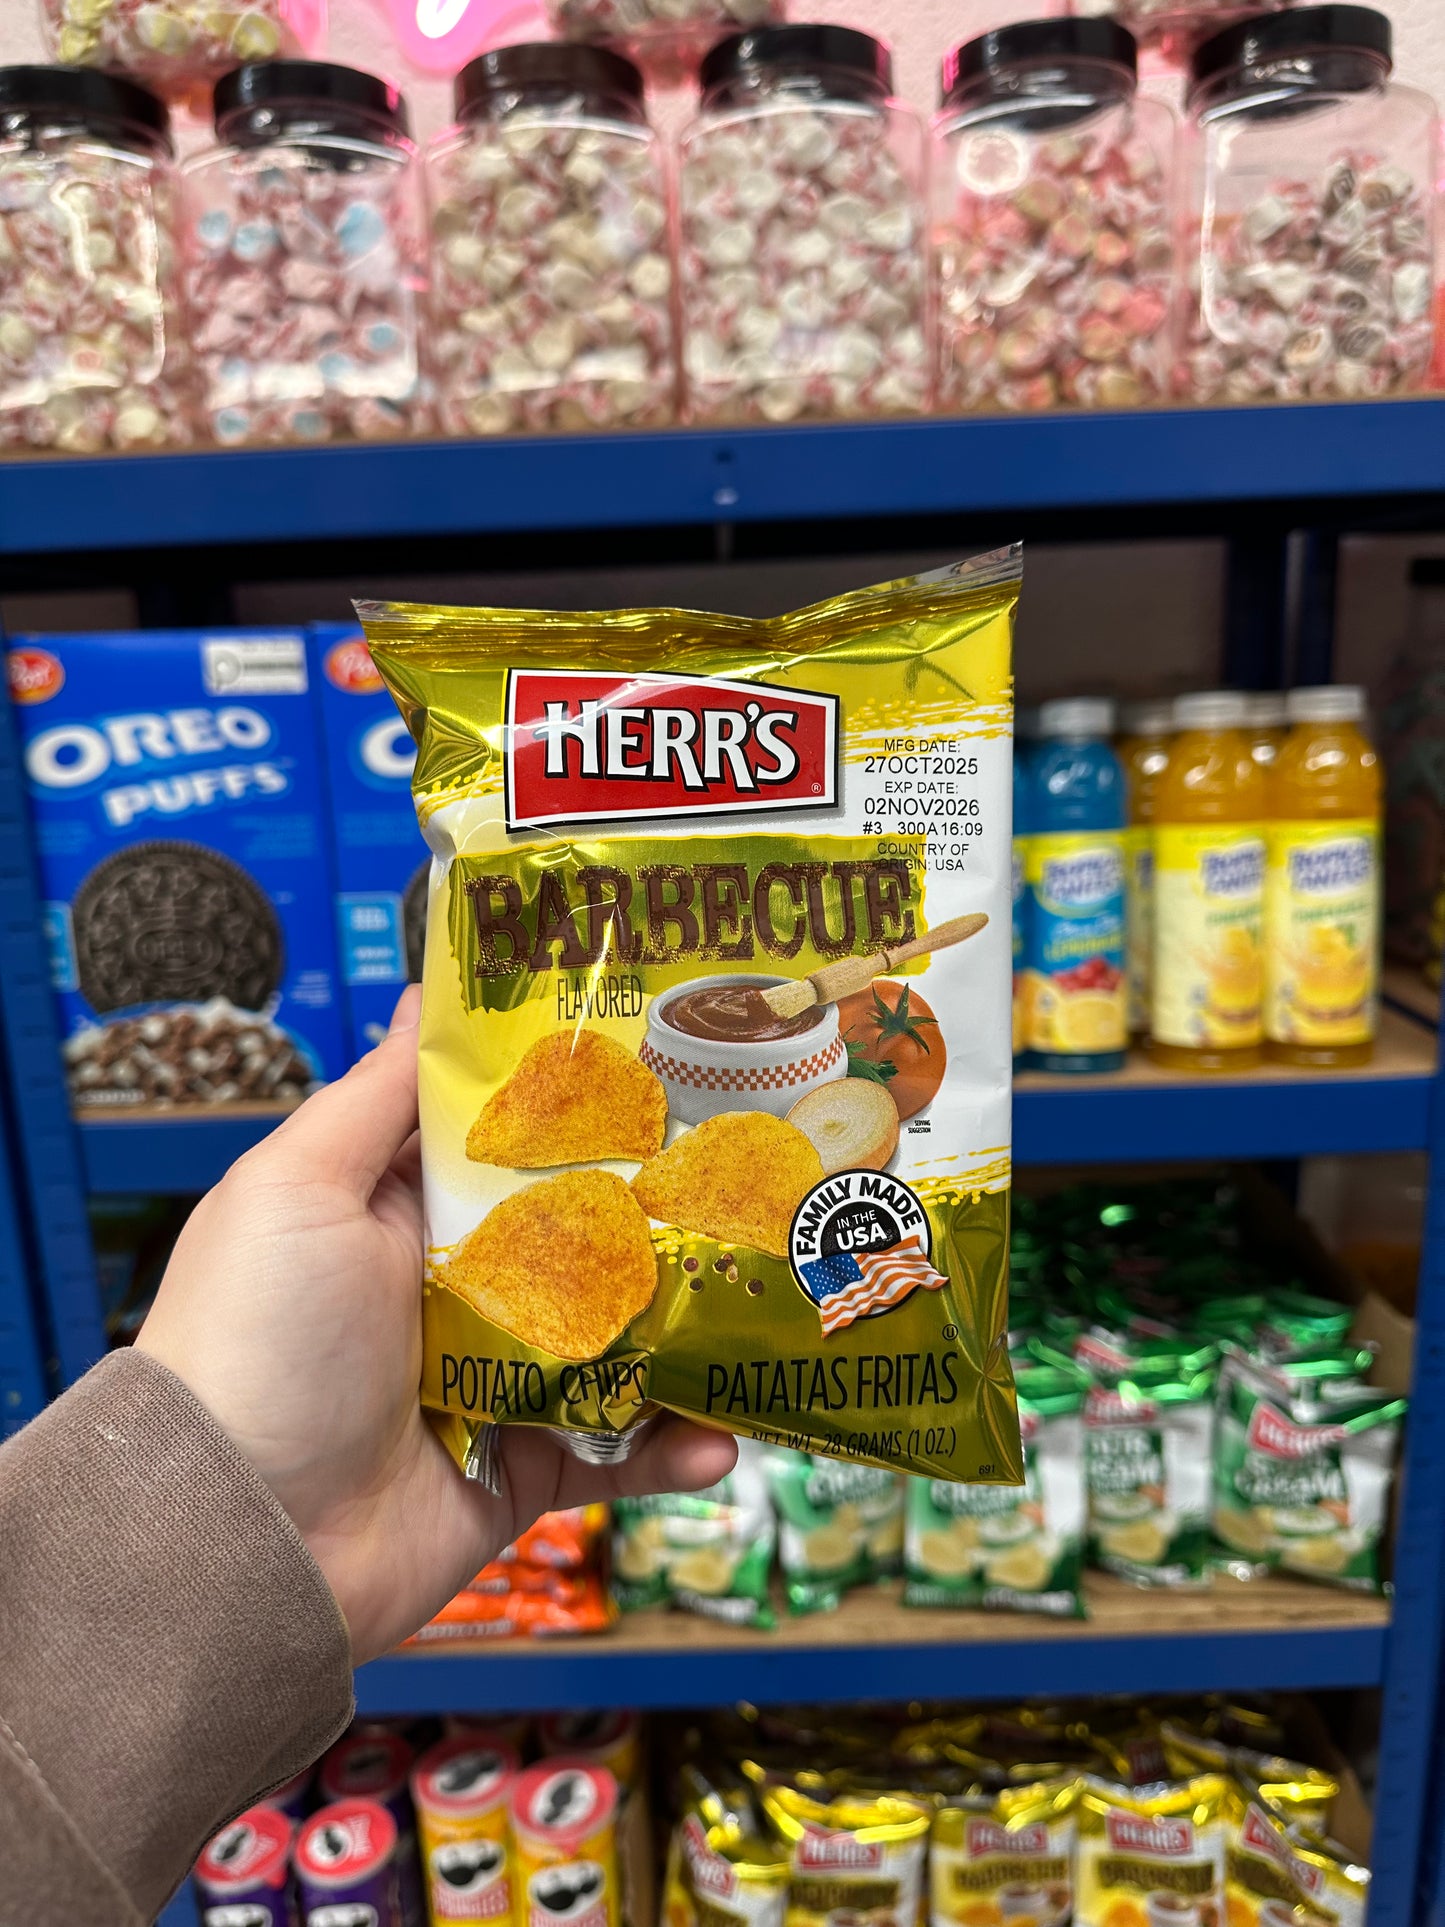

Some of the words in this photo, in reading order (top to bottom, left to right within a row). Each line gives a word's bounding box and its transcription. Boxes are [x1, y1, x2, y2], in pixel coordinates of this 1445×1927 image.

[24, 706, 271, 788] OREO
[532, 699, 799, 792] HERR'S
[884, 739, 915, 752] MFG
[919, 739, 961, 753] DATE:
[864, 755, 978, 775] 27OCT2025
[103, 762, 287, 827] PUFFS
[884, 781, 913, 793] EXP
[917, 782, 959, 794] DATE:
[864, 797, 980, 816] 02NOV2026
[863, 821, 883, 835] #3
[877, 842, 947, 856] COUNTRY
[950, 843, 970, 856] OF
[877, 858, 931, 871] ORIGIN:
[935, 859, 965, 871] USA
[464, 860, 918, 979] BARBECUE
[557, 974, 643, 1021] FLAVORED
[796, 1177, 852, 1256] FAMILY
[859, 1176, 923, 1231] MADE
[836, 1218, 850, 1230] IN
[852, 1209, 878, 1225] THE
[836, 1222, 888, 1251] USA
[442, 1353, 547, 1415] POTATO
[559, 1361, 648, 1408] CHIPS
[706, 1356, 848, 1413] PATATAS
[857, 1351, 958, 1409] FRITAS
[821, 1432, 841, 1455] 28
[846, 1430, 903, 1458] GRAMS
[925, 1426, 957, 1458] OZ.)
[978, 1464, 996, 1475] 691
